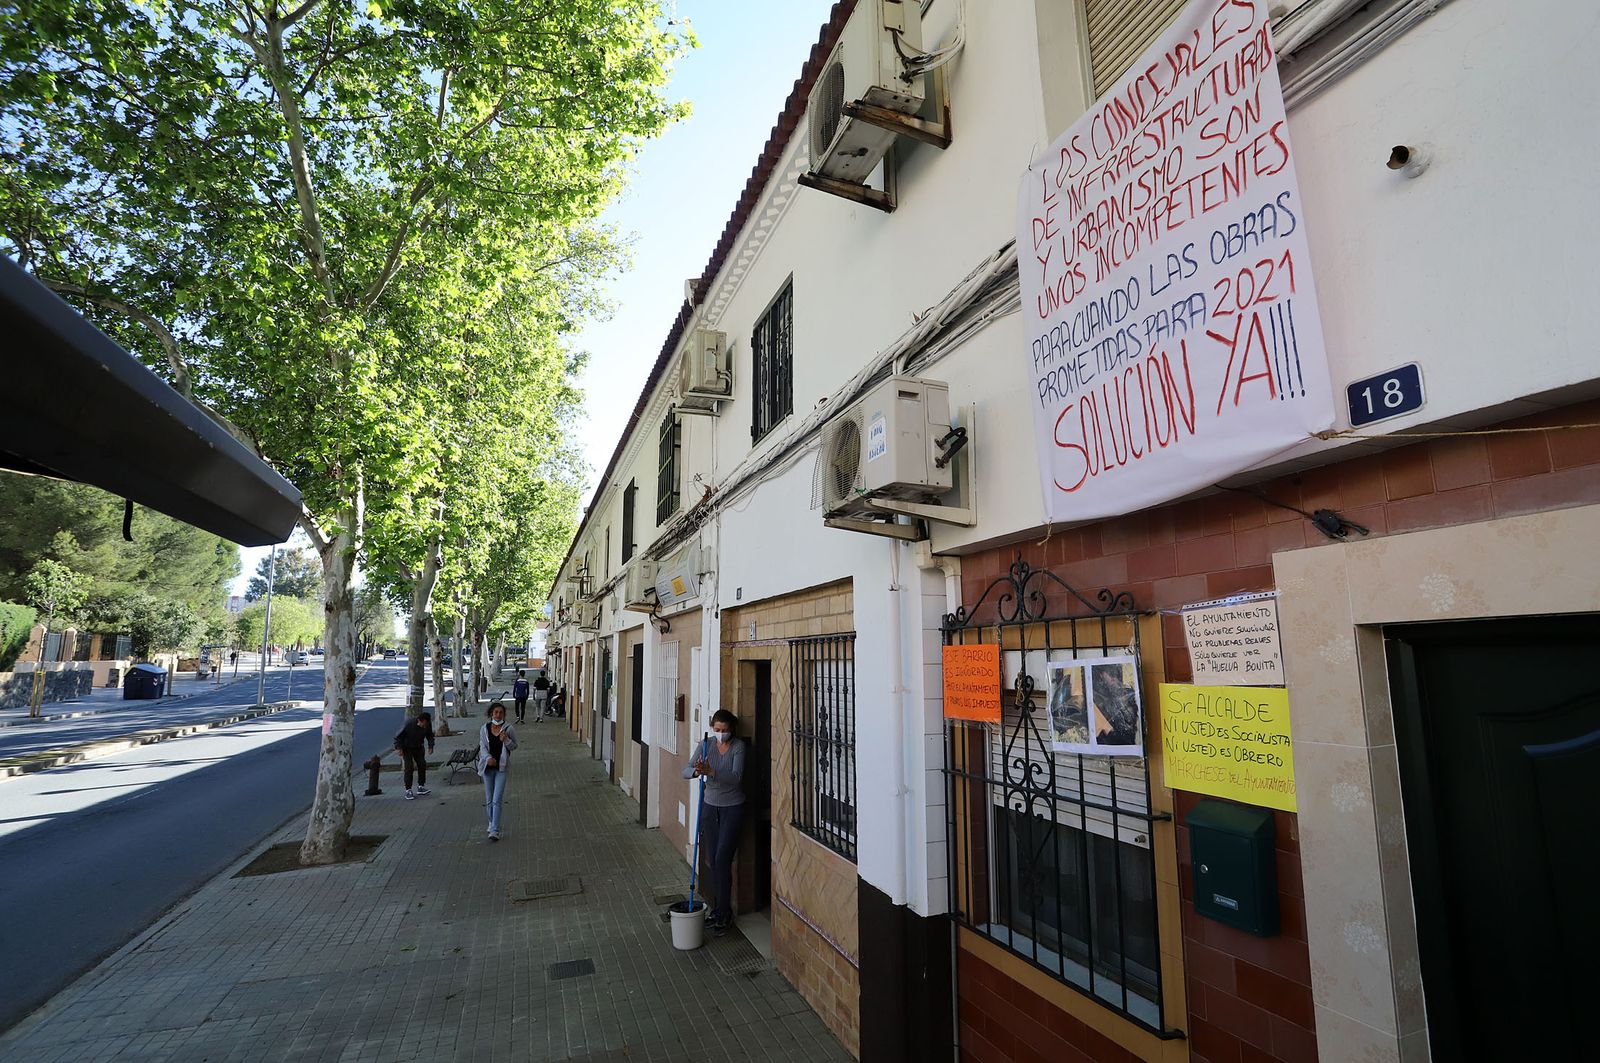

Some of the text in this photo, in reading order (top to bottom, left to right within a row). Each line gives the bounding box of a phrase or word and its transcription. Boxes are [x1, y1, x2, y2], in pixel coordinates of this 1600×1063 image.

[1043, 0, 1255, 204] LOS CONCEJALES
[1032, 19, 1272, 251] DE INFRAESTRUCTURAS
[1037, 79, 1261, 285] Y URBANISMO SON
[1038, 121, 1289, 319] UNOS INCOMPETENTES
[1150, 242, 1198, 296] LAS
[1210, 190, 1297, 265] OBRAS
[1037, 249, 1296, 409] PROMETIDAS PARA 2021
[1361, 378, 1404, 415] 18
[1054, 338, 1196, 493] SOLUCIÓN
[1186, 607, 1272, 627] EL AYUNTAMIENTO
[1189, 627, 1202, 638] NO
[962, 648, 993, 663] BARRIO
[1191, 641, 1203, 649] LOS
[1243, 649, 1261, 657] VER
[1196, 662, 1206, 672] LA
[1168, 690, 1274, 723] Sr. ALCALDE
[1181, 720, 1216, 738] USTED
[1216, 727, 1230, 740] ES
[1182, 738, 1217, 758] USTED
[1220, 747, 1232, 758] ES
[1233, 745, 1284, 767] OBRERO
[1243, 769, 1297, 795] AYUNTAMIENTO
